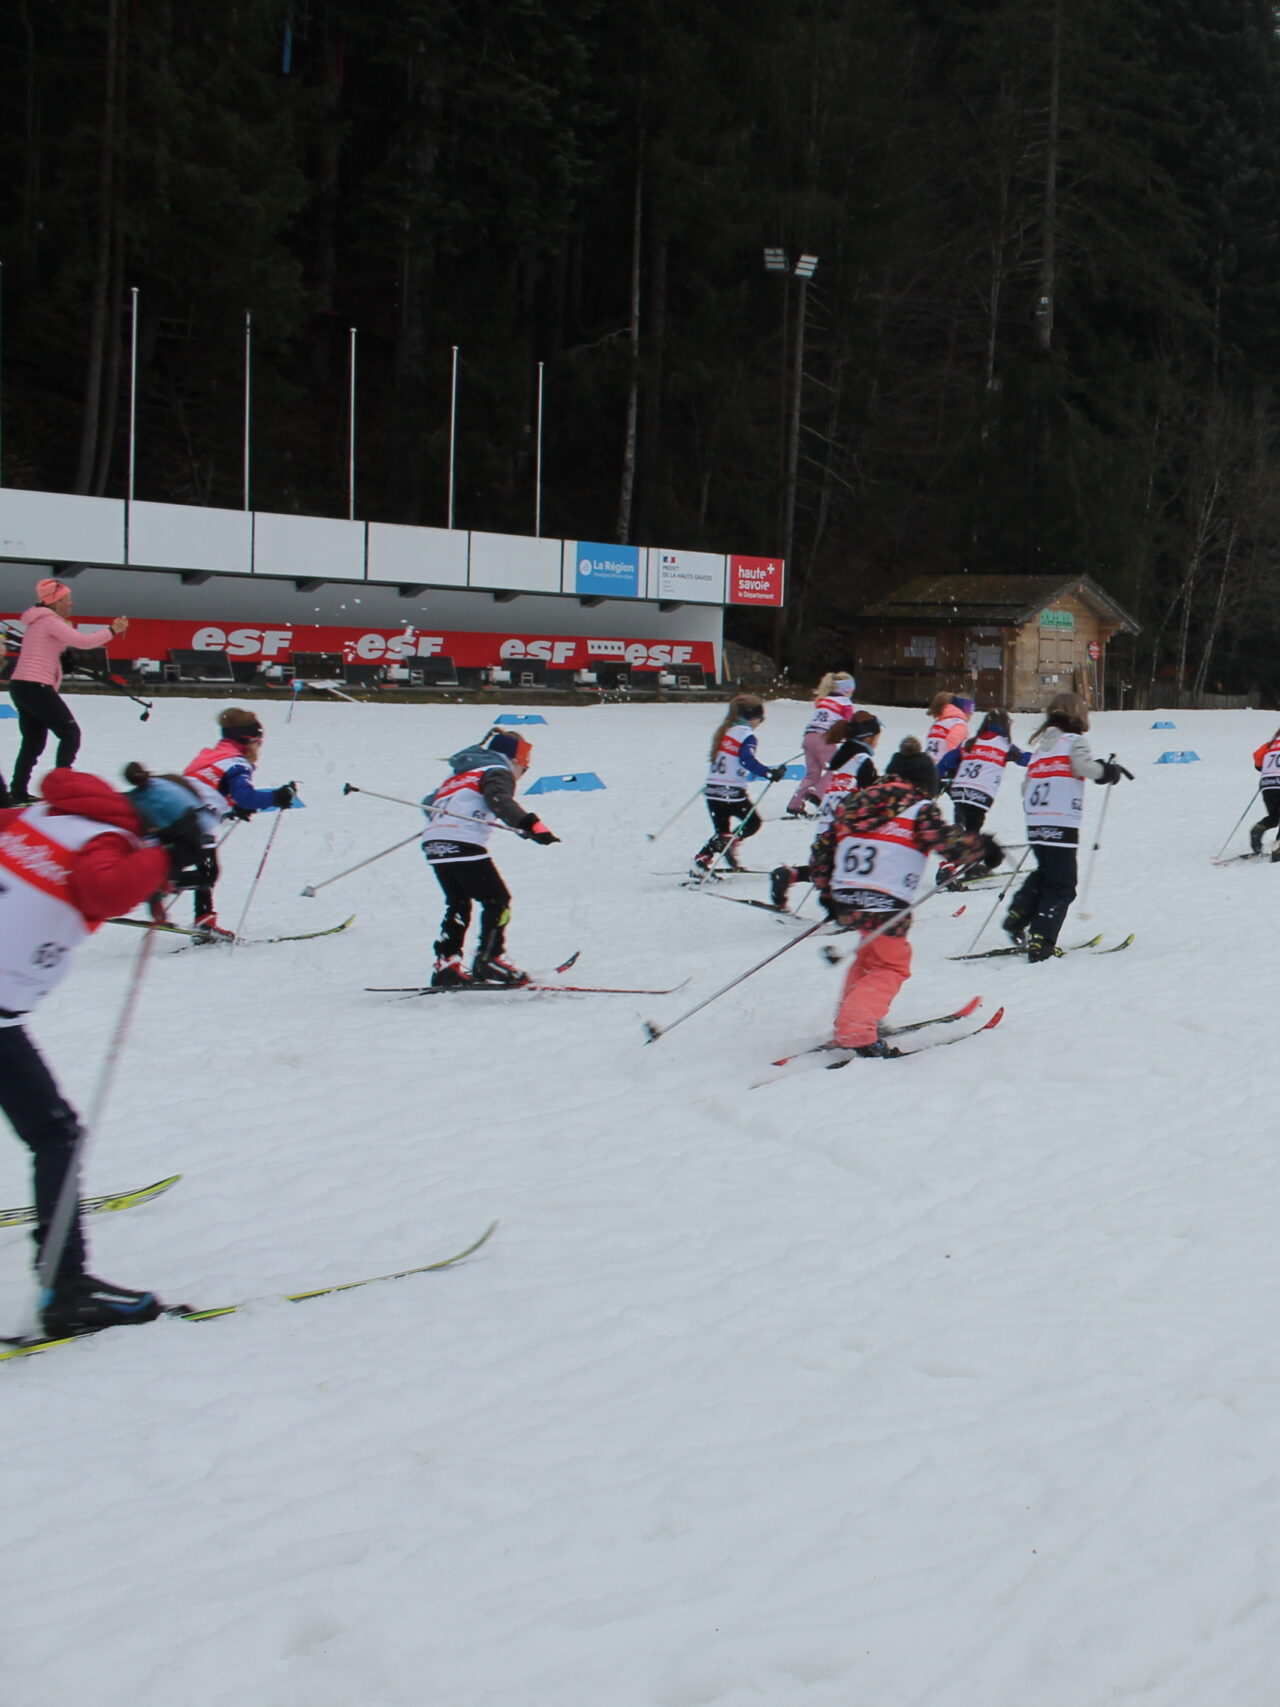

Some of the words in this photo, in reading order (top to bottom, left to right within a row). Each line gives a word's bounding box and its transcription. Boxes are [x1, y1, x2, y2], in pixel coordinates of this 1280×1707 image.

[593, 560, 604, 570] La
[604, 560, 634, 574] Région
[738, 564, 766, 580] haute
[738, 579, 770, 591] savoie
[1030, 782, 1051, 807] 62
[844, 844, 877, 875] 63
